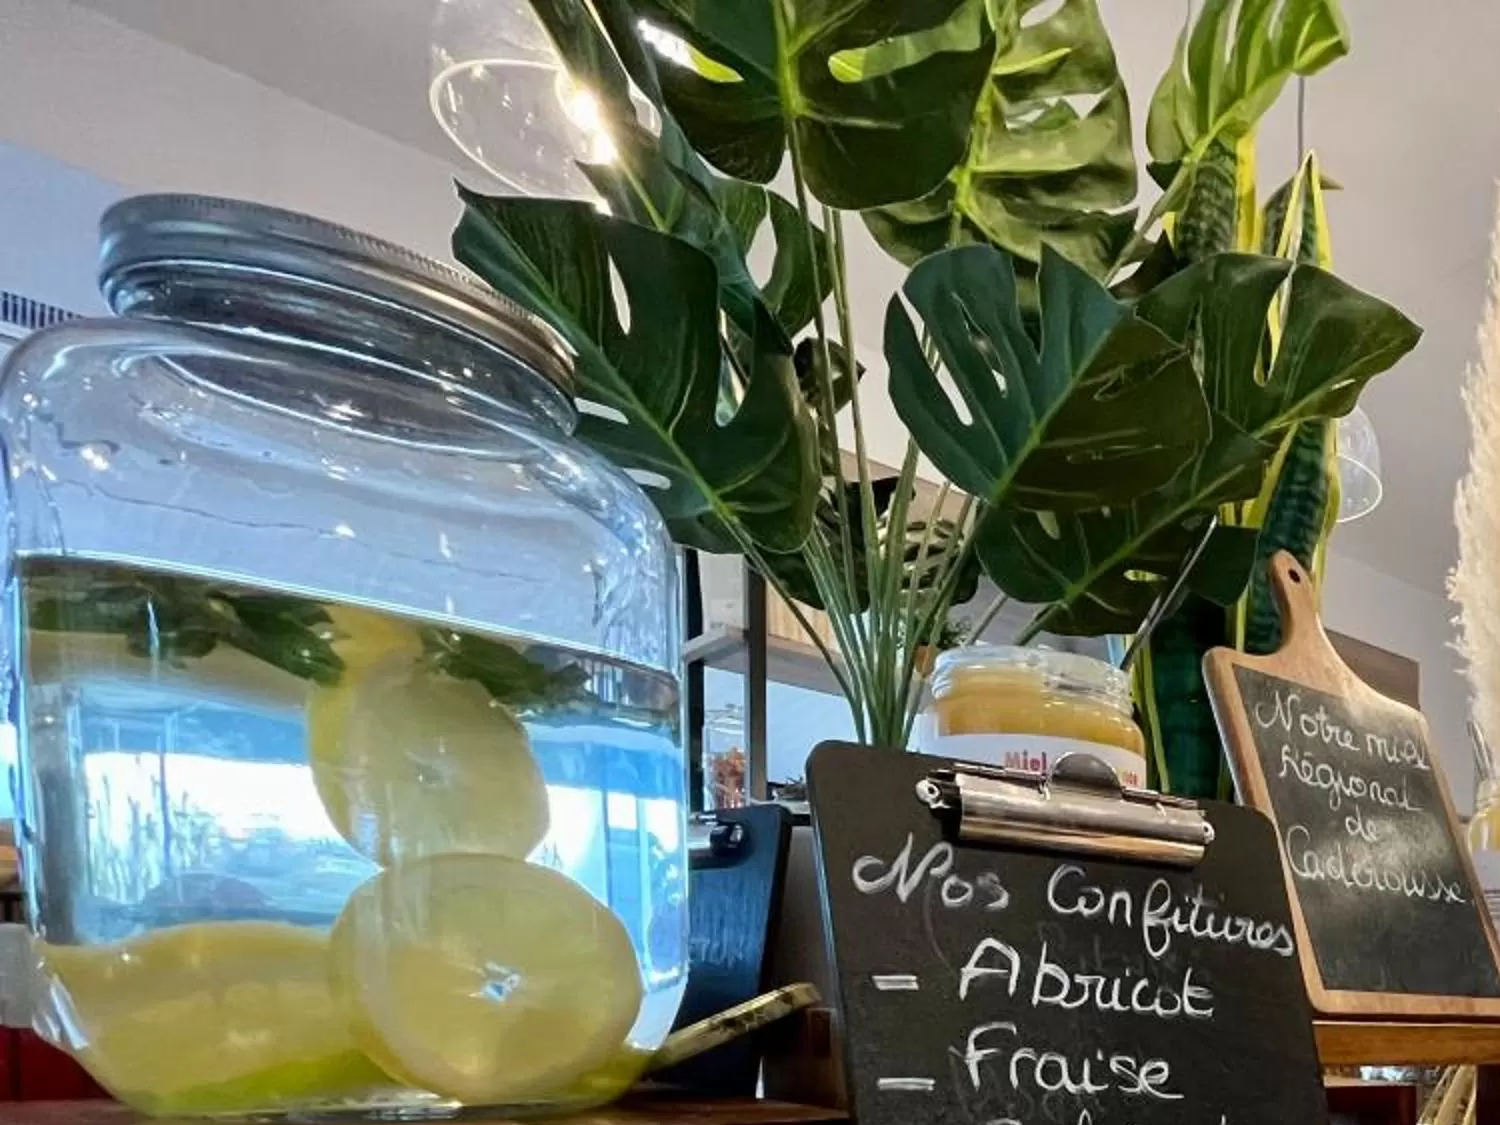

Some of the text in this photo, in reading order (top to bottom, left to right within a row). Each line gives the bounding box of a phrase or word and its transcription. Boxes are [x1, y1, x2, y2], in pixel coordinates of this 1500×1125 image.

[1004, 750, 1047, 771] Miel
[1344, 804, 1379, 842] de
[852, 831, 1296, 960] Nos Confitures
[958, 937, 1215, 1018] Abricot
[963, 1021, 1185, 1099] Fraise
